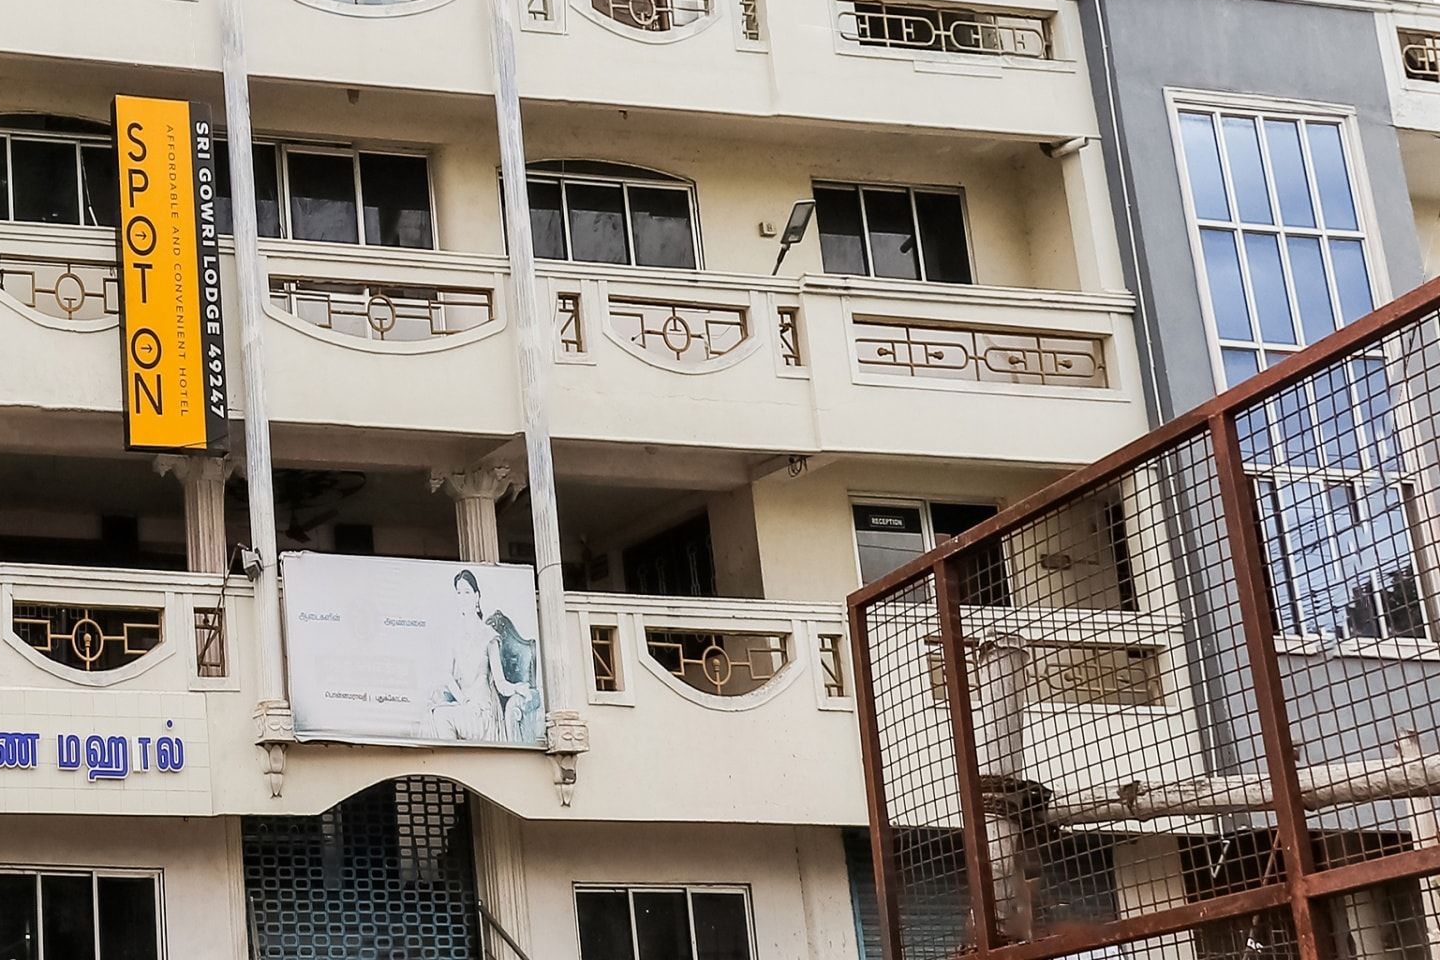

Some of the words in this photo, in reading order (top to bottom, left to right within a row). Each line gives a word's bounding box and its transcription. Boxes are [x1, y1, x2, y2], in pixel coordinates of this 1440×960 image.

[166, 124, 180, 219] AFFORDABLE
[196, 122, 210, 160] SRI
[126, 122, 157, 304] SPOT
[172, 226, 181, 256] AND
[198, 167, 216, 247] GOWRI
[173, 263, 186, 360] CONVENIENT
[203, 255, 221, 335] LODGE
[131, 327, 163, 416] ON
[179, 367, 189, 417] HOTEL
[207, 343, 225, 419] 49247
